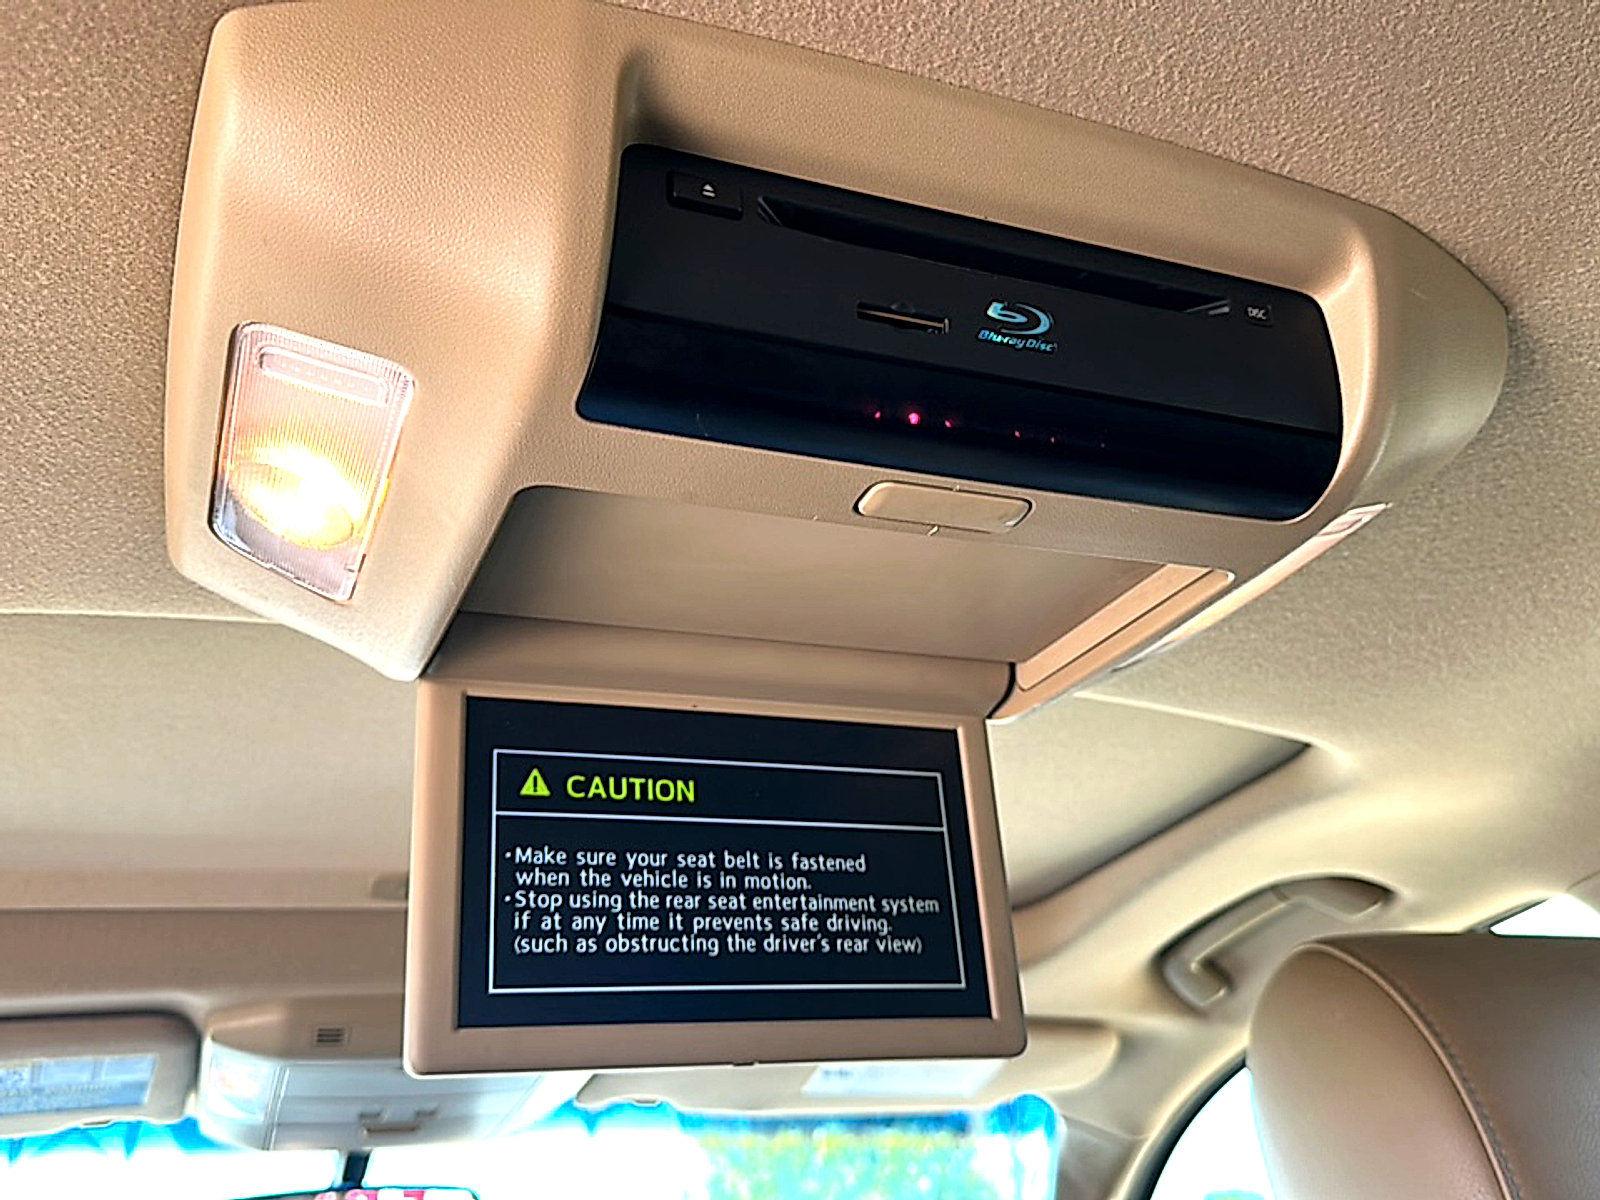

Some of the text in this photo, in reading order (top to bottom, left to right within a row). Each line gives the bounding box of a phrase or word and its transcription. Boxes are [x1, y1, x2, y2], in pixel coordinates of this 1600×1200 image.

[1025, 338, 1054, 352] Disc
[566, 775, 695, 803] CAUTION
[514, 846, 867, 873] Make sure your seat belt is fastened
[515, 867, 812, 891] when the vehicle is in motion.
[514, 889, 940, 918] Stop using the rear seat entertainment system
[513, 910, 893, 938] if at any time it prevents safe driving.
[513, 931, 923, 957] (such as obstructing the driver's rear view)
